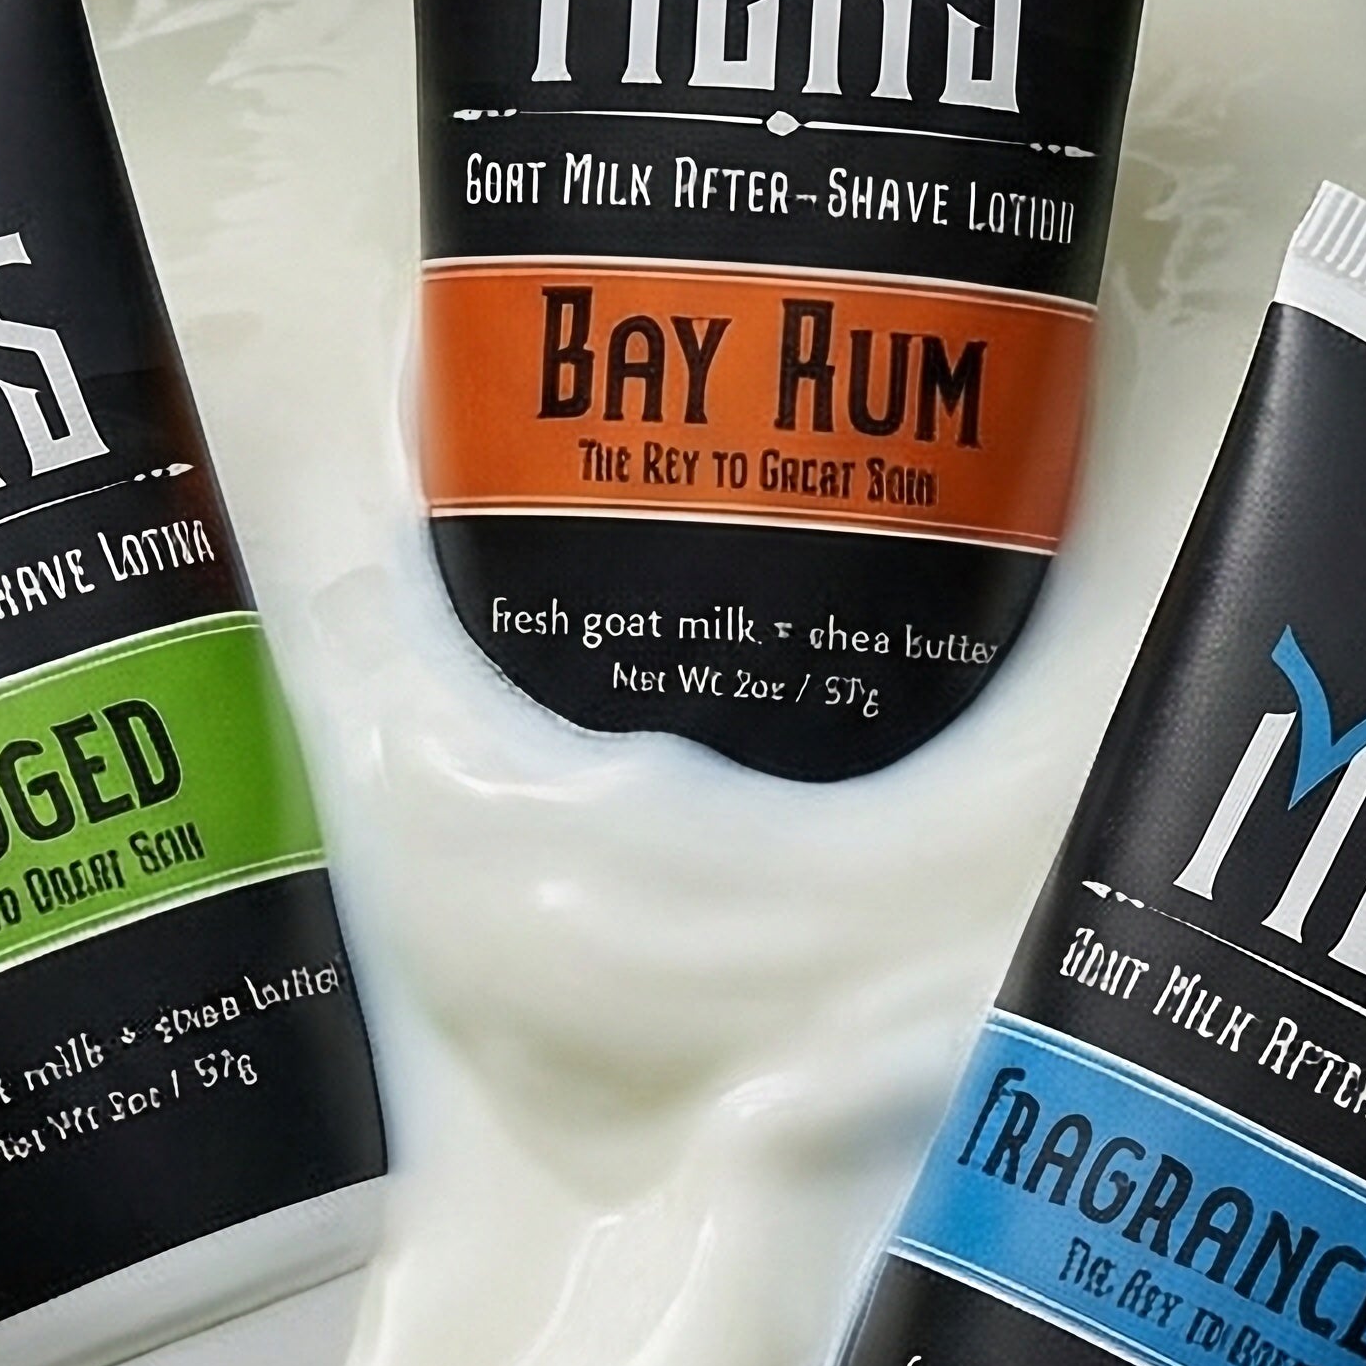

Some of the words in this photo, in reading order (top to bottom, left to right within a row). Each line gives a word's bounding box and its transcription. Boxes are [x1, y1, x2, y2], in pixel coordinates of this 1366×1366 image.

[537, 285, 732, 425] BAY
[774, 298, 989, 450] RUM
[583, 609, 662, 648] goat
